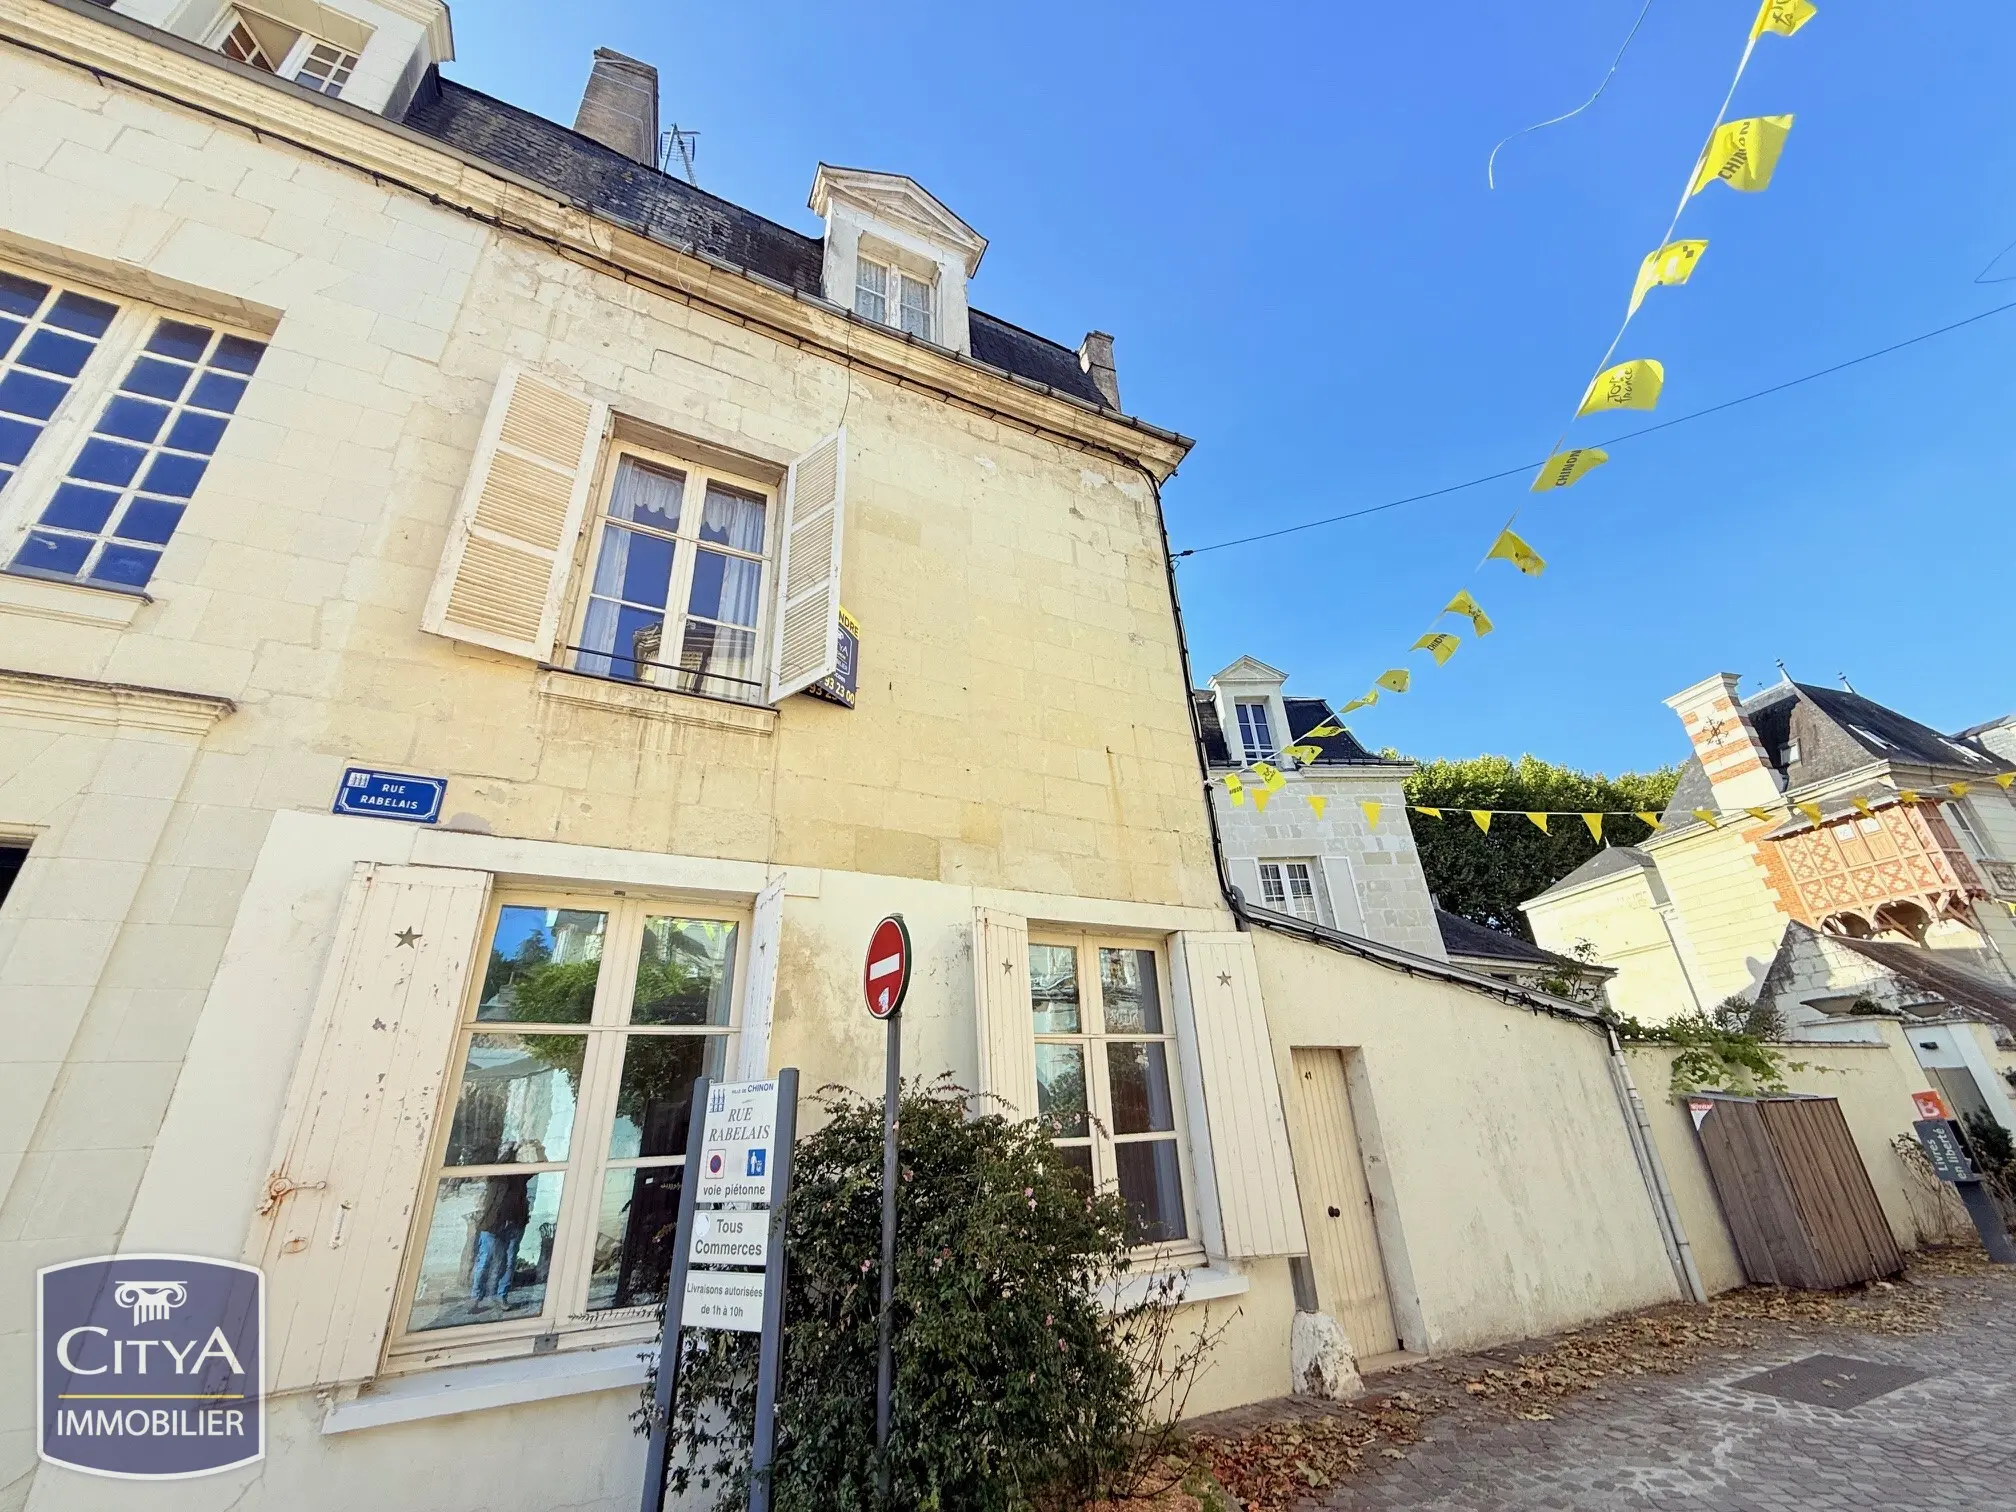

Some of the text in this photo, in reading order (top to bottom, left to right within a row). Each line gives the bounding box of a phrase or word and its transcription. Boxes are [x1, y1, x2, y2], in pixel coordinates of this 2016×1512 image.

[1556, 449, 1582, 487] CHINON
[838, 610, 859, 637] NDRE
[836, 682, 845, 697] 23
[846, 690, 855, 704] 00
[381, 783, 406, 794] RUE
[360, 794, 418, 809] RABELAIS
[747, 1083, 774, 1093] CHINON
[728, 1107, 753, 1122] RUE
[708, 1124, 770, 1142] RABELAIS
[1927, 1139, 1949, 1171] Livres
[1932, 1128, 1967, 1180] en liberté
[703, 1183, 766, 1198] voie piétonne
[717, 1219, 743, 1234] Tous
[695, 1239, 762, 1256] Commerces
[687, 1283, 763, 1298] Livraisons autorisées
[701, 1304, 744, 1317] de 1h à 10h
